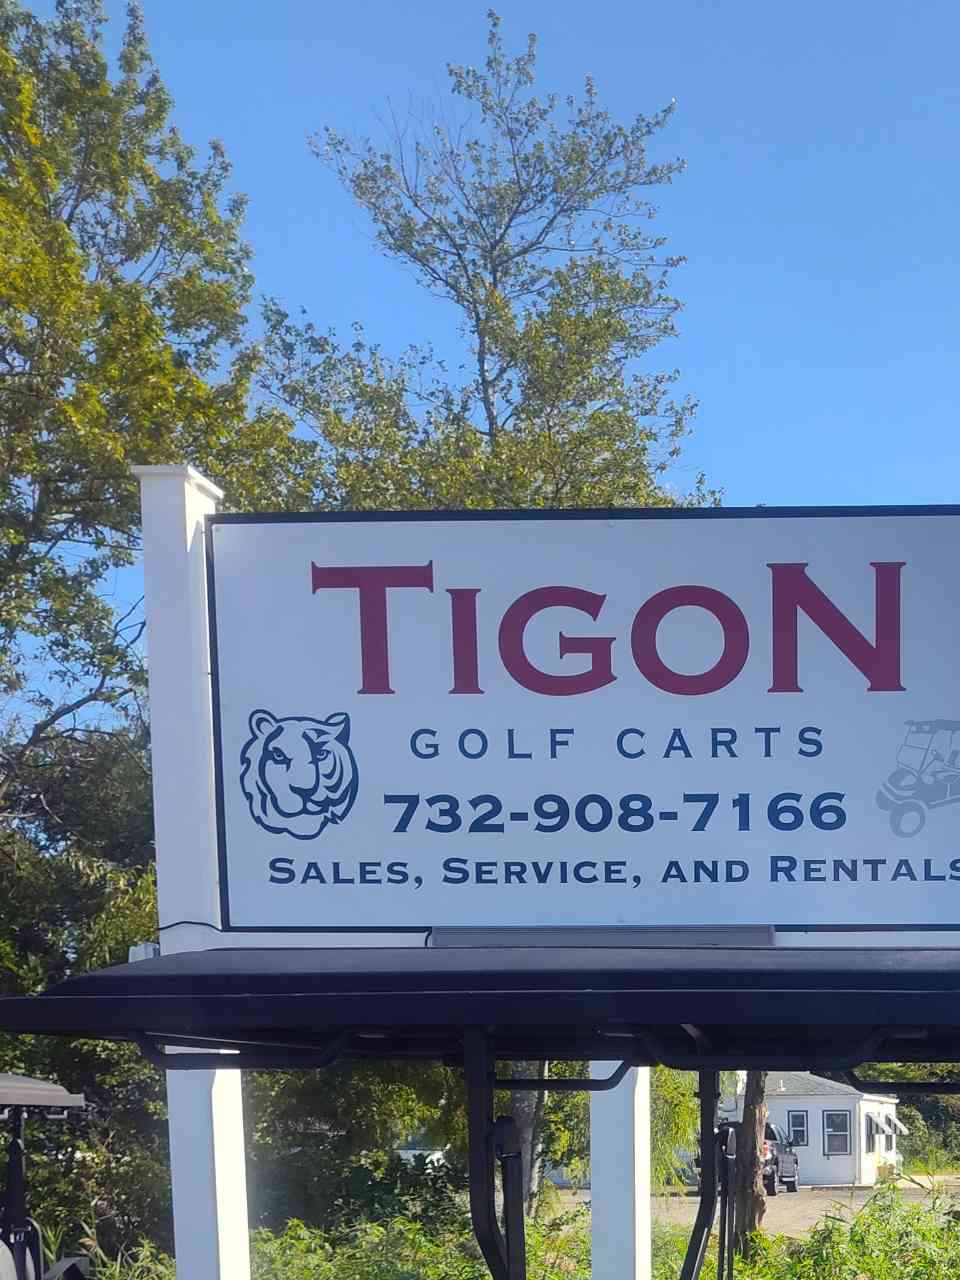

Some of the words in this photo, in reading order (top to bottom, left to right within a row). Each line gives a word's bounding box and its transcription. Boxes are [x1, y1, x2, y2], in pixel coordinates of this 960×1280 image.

[310, 560, 907, 697] TIGON
[409, 727, 575, 761] GOLF
[616, 725, 824, 761] CARTS
[383, 791, 848, 835] 732-908-7166
[266, 856, 424, 891] SALES,
[441, 856, 643, 889] SERVICE,
[659, 857, 750, 884] AND
